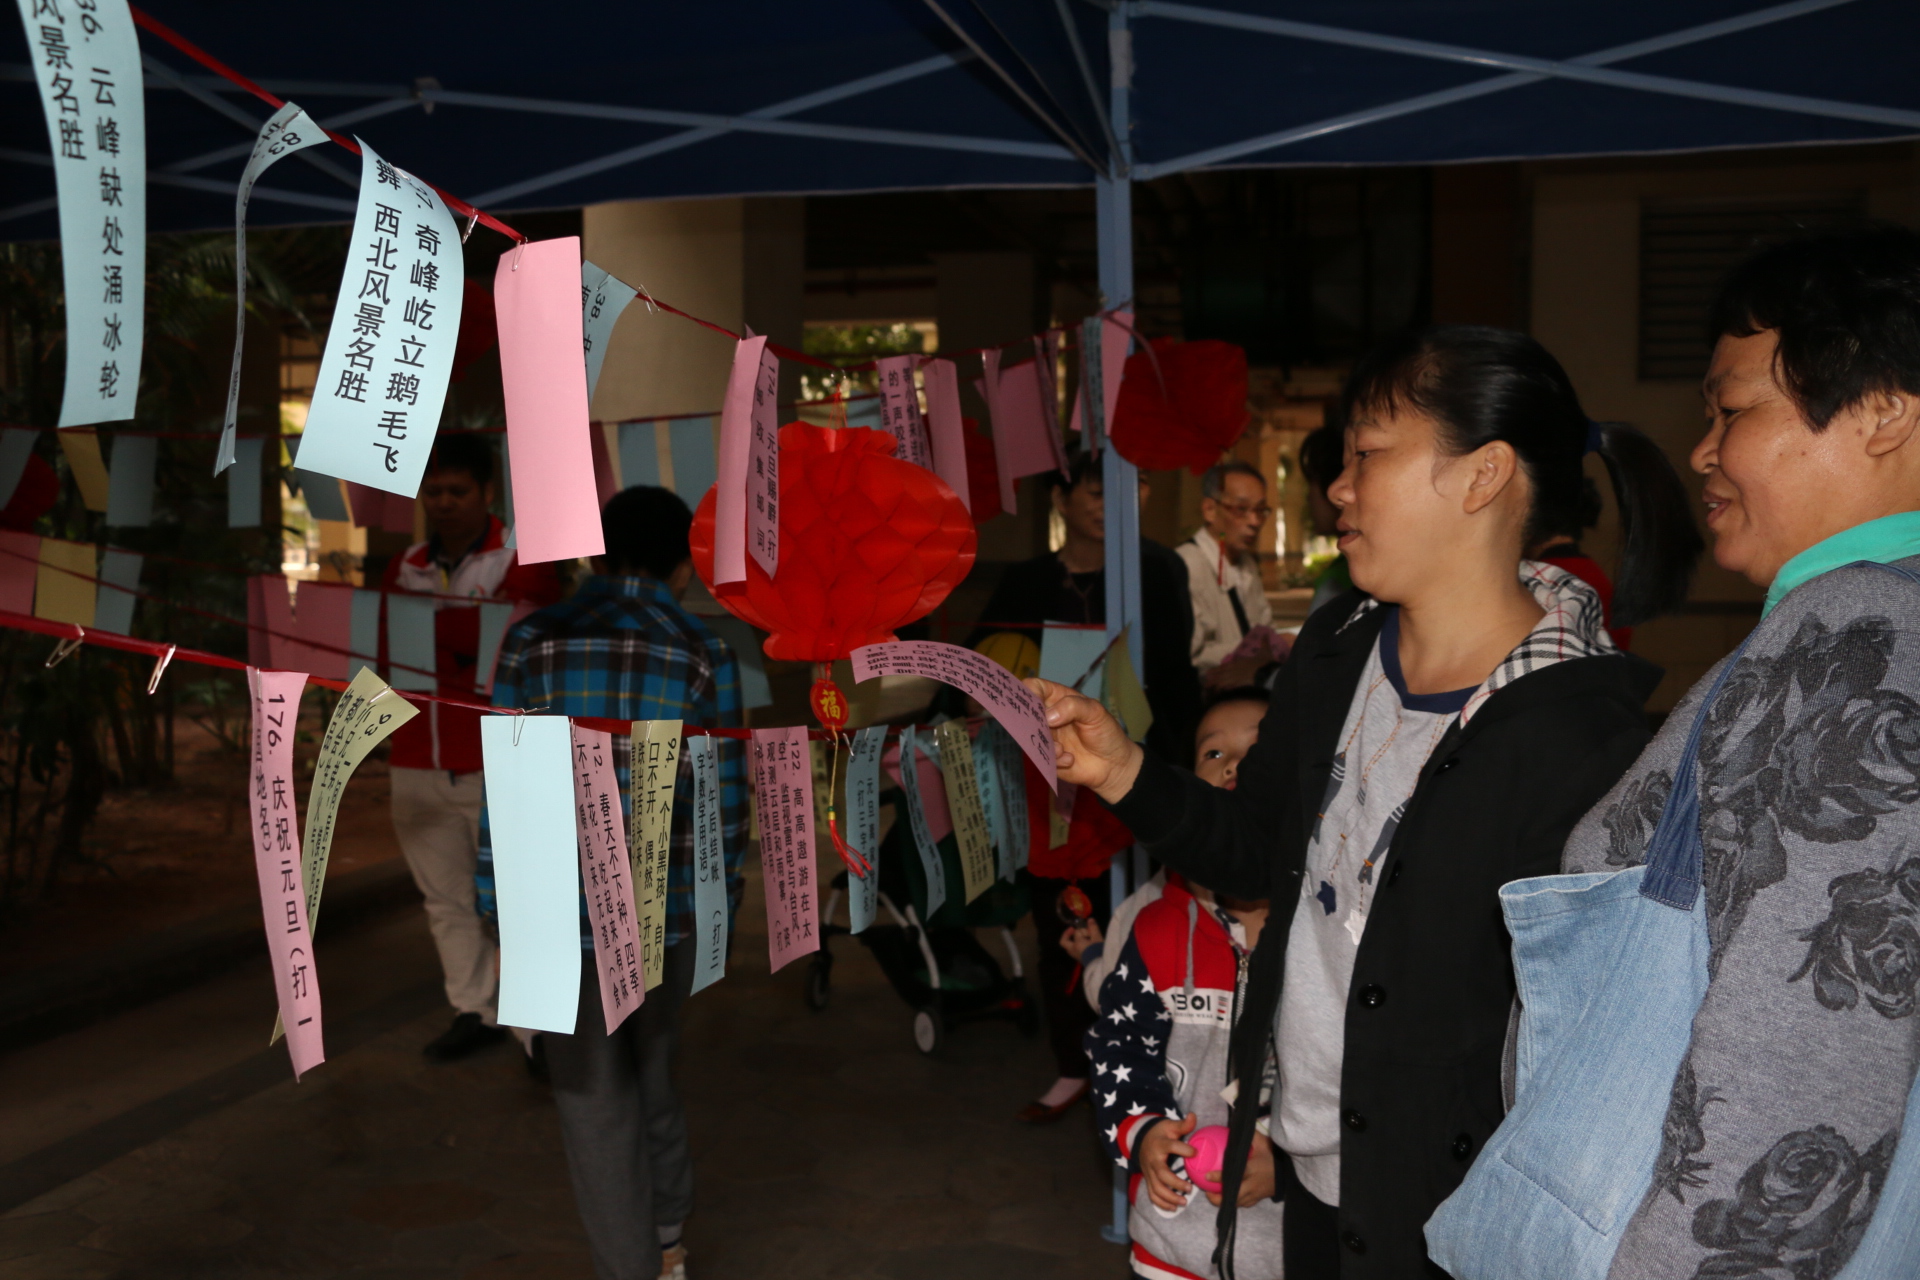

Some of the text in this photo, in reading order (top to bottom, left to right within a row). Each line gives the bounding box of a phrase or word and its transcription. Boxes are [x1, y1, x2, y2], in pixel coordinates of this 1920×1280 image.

[89, 66, 124, 400] 云峰缺处涌冰轮
[335, 202, 403, 404] 西北风景名胜
[372, 222, 442, 474] 奇峰屹立鹅毛飞
[819, 688, 841, 720] 福
